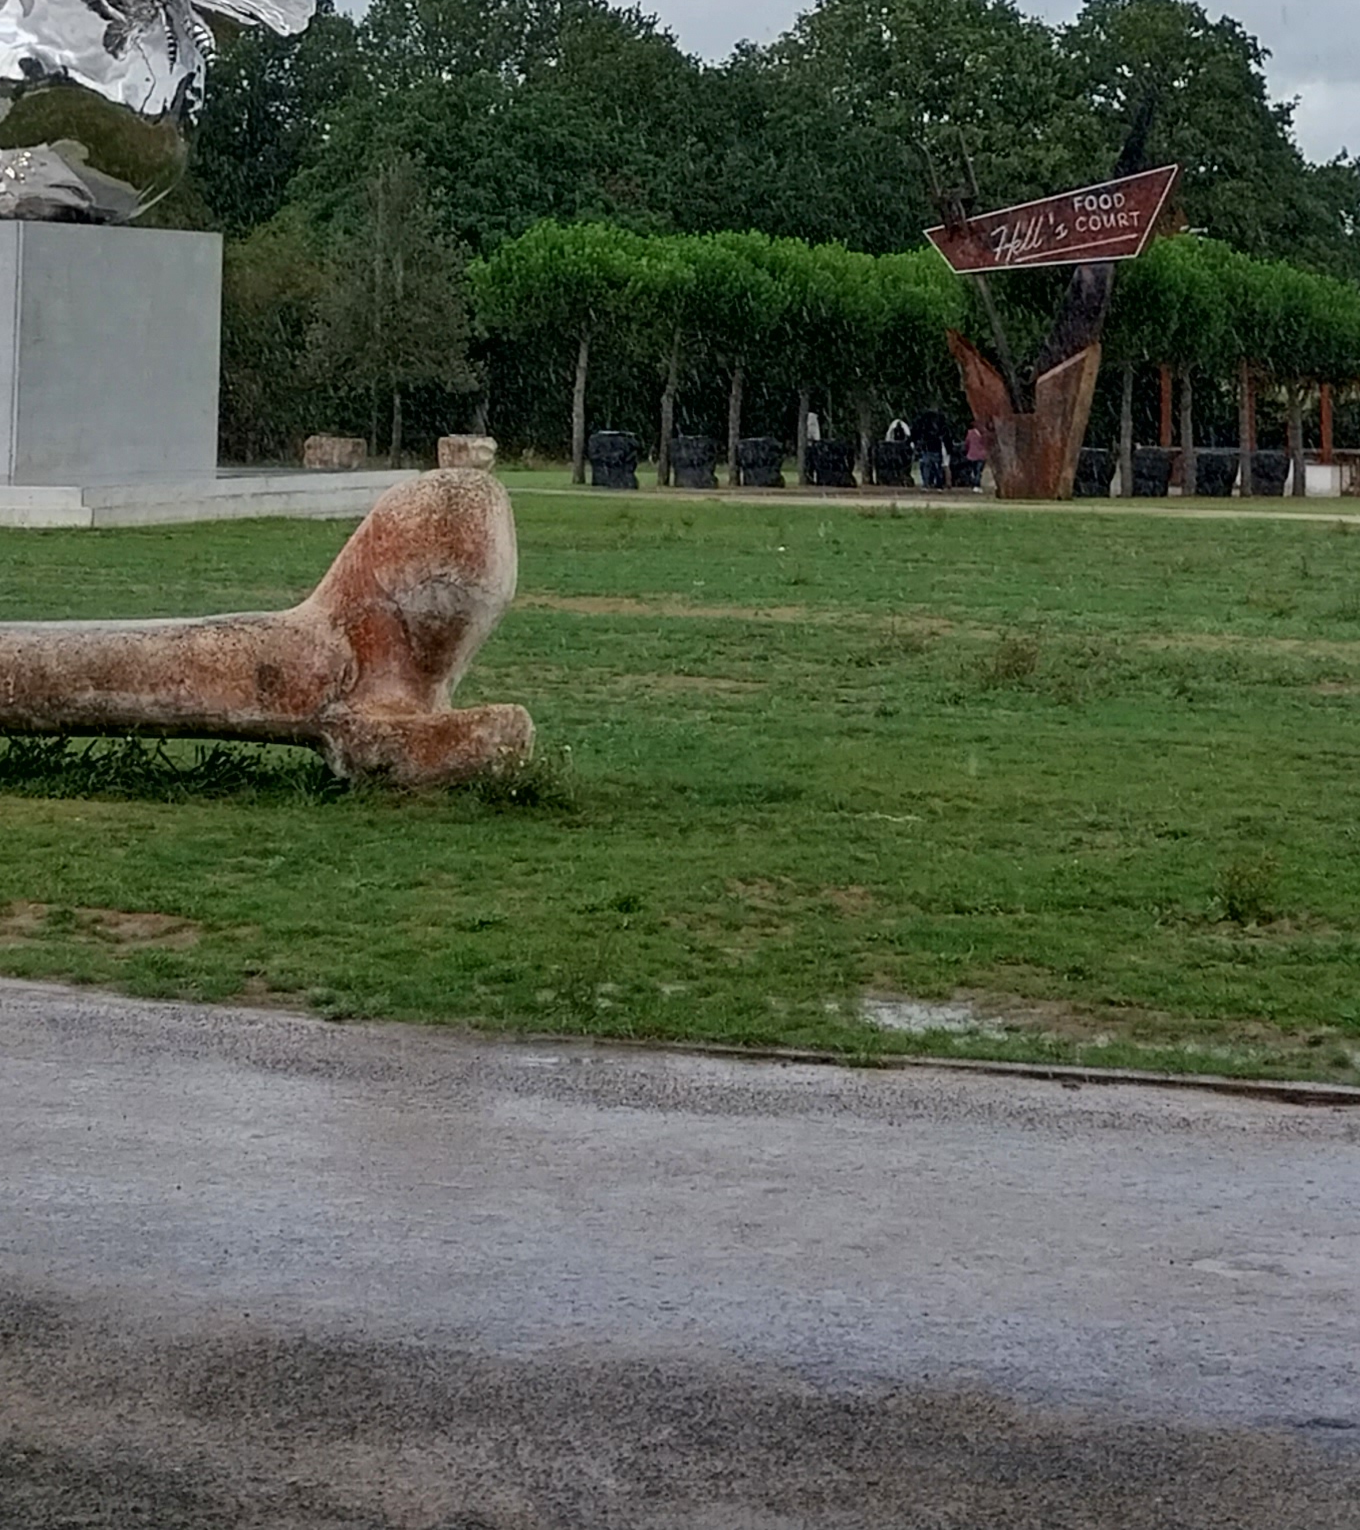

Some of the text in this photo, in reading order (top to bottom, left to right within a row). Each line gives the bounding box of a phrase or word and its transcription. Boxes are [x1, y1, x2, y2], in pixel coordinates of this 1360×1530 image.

[1073, 192, 1125, 212] FOOD
[1075, 211, 1140, 232] COURT
[990, 211, 1068, 265] Hell's
